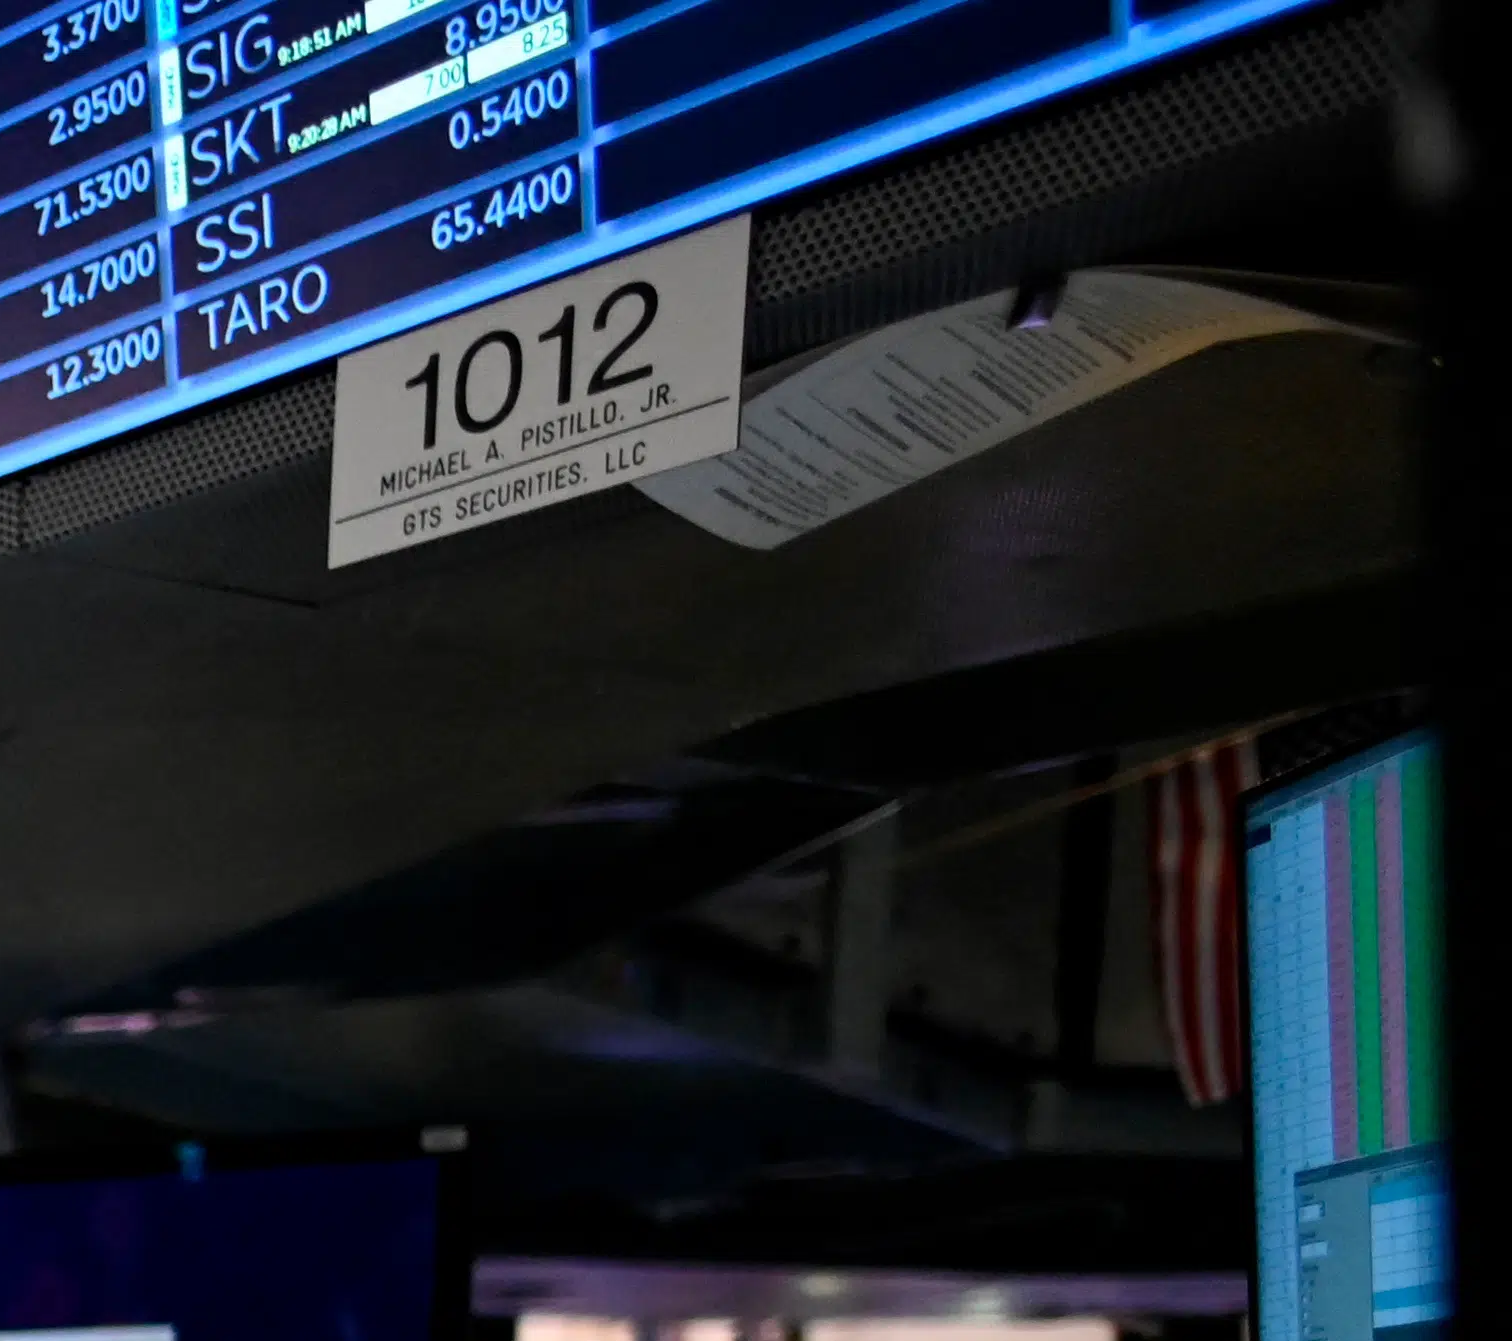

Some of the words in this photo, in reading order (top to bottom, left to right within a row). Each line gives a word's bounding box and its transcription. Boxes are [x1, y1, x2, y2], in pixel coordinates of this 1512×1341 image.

[42, 0, 140, 62] 3.3700
[184, 14, 273, 99] SIG
[444, 0, 565, 57] 8.9500
[333, 12, 363, 43] AM
[47, 69, 146, 147] 2.9500
[190, 92, 293, 188] SKT
[447, 69, 570, 149] 0.5400
[337, 103, 368, 134] AM
[33, 156, 151, 236] 71.5300
[194, 193, 274, 278] SSI
[430, 164, 574, 251] 65.4400
[40, 241, 156, 319] 14.7000
[197, 263, 330, 352] TARO
[45, 325, 161, 401] 12.3000
[405, 280, 659, 451] 1012
[380, 451, 471, 496] MICHAEL
[641, 383, 677, 414] JR.
[402, 504, 442, 537] GTS
[605, 441, 646, 475] LLC
